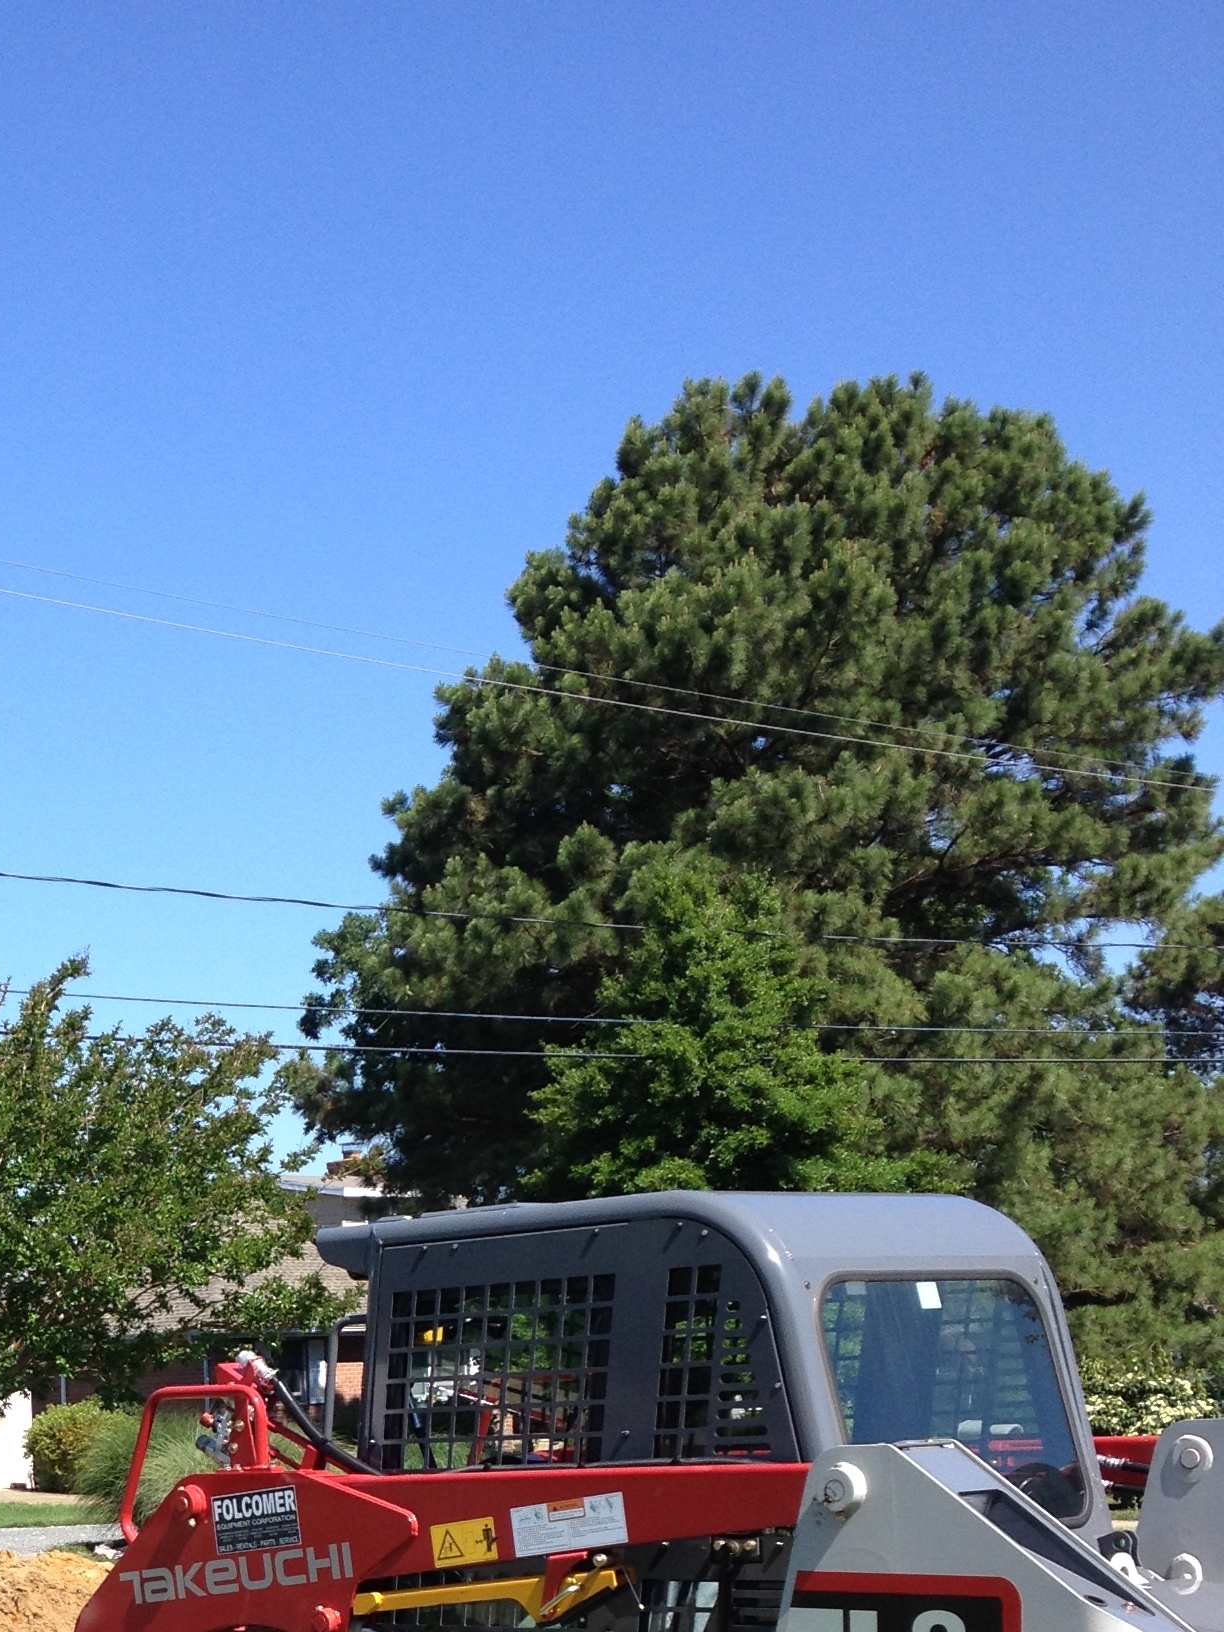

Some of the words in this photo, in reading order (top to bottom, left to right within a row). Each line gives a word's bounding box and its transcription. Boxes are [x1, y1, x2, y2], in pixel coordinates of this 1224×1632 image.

[213, 1490, 296, 1521] FOLCOMER
[217, 1520, 251, 1531] EQUIPMENT
[251, 1514, 296, 1526] CORPORATION
